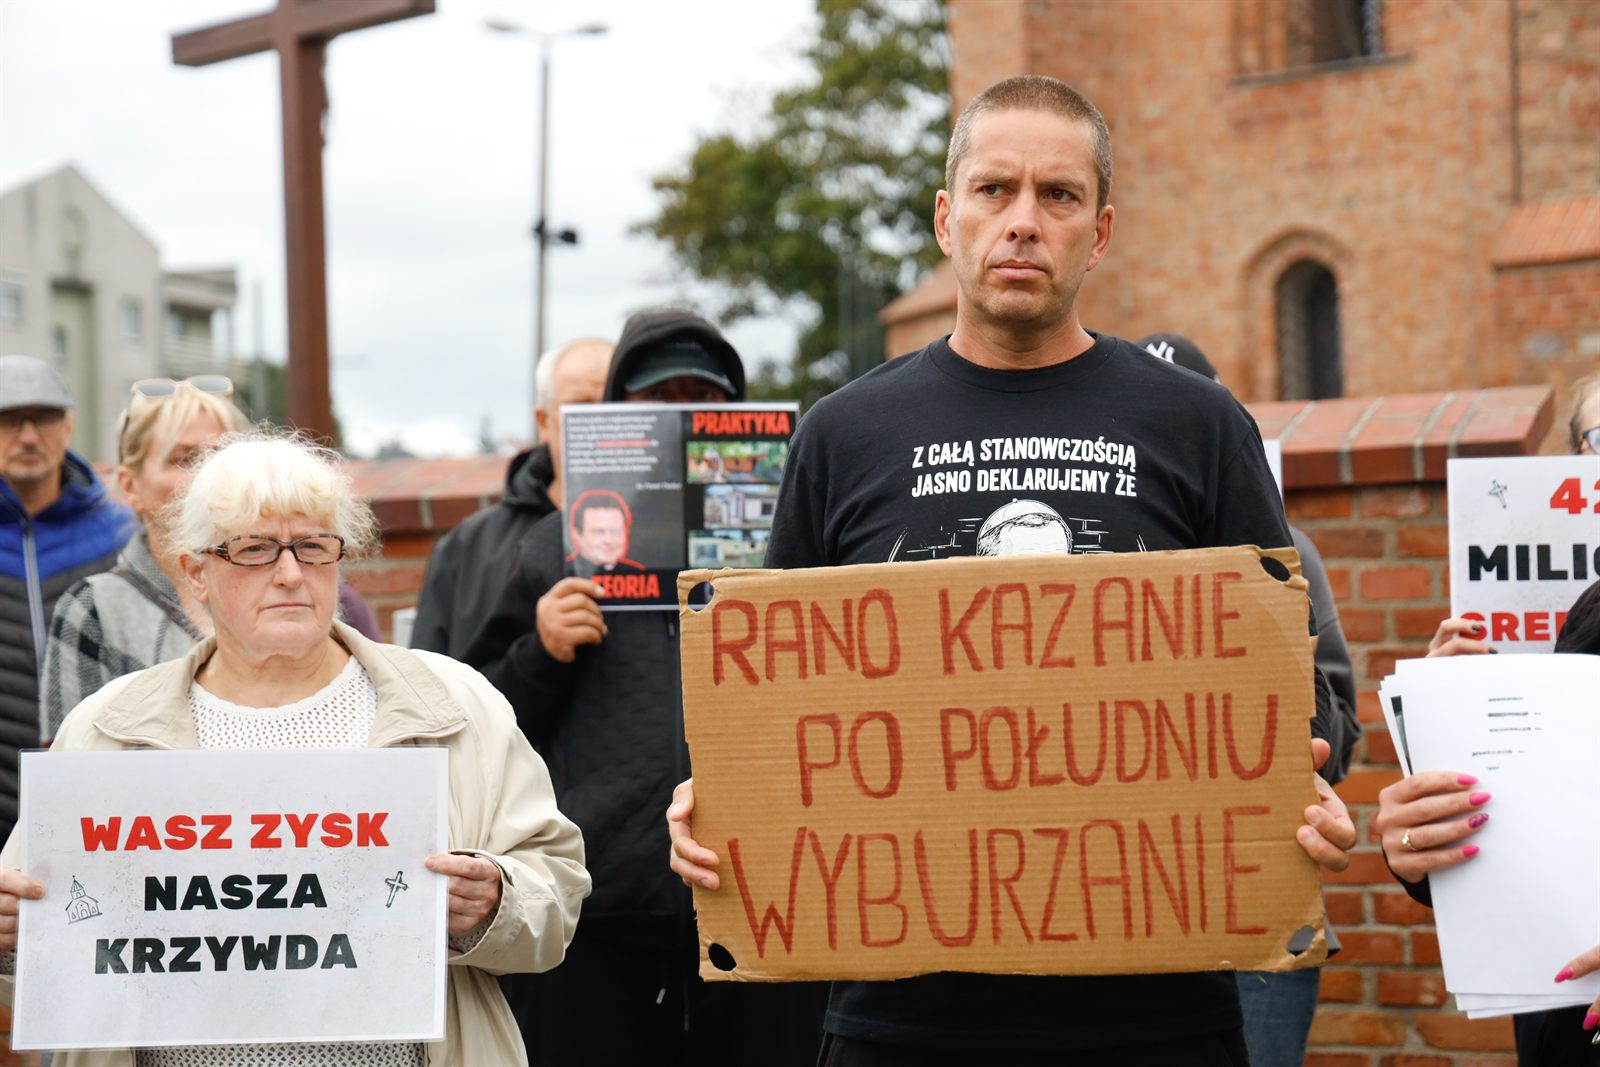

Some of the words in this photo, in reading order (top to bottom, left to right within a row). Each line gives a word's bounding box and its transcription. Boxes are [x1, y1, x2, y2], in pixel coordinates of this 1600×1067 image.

[692, 411, 790, 435] PRAKTYKA
[911, 446, 924, 468] Z
[928, 440, 975, 467] CAŁĄ
[980, 436, 1137, 473] STANOWCZOŚCIĄ
[911, 470, 971, 497] JASNO
[976, 467, 1110, 494] DEKLARUJEMY
[1114, 472, 1138, 497] ŻE
[1550, 477, 1600, 515] 4
[1468, 543, 1600, 581] MILI
[711, 588, 901, 687] RANO
[939, 571, 1248, 676] KAZANIE
[795, 710, 904, 808] PO
[939, 692, 1279, 792] POŁUDNIU
[80, 814, 233, 852] WASZ
[250, 812, 389, 849] ZYSK
[144, 873, 328, 912] NASZA
[727, 806, 1272, 960] WYBURZANIE
[94, 933, 358, 975] KRZYWDA
